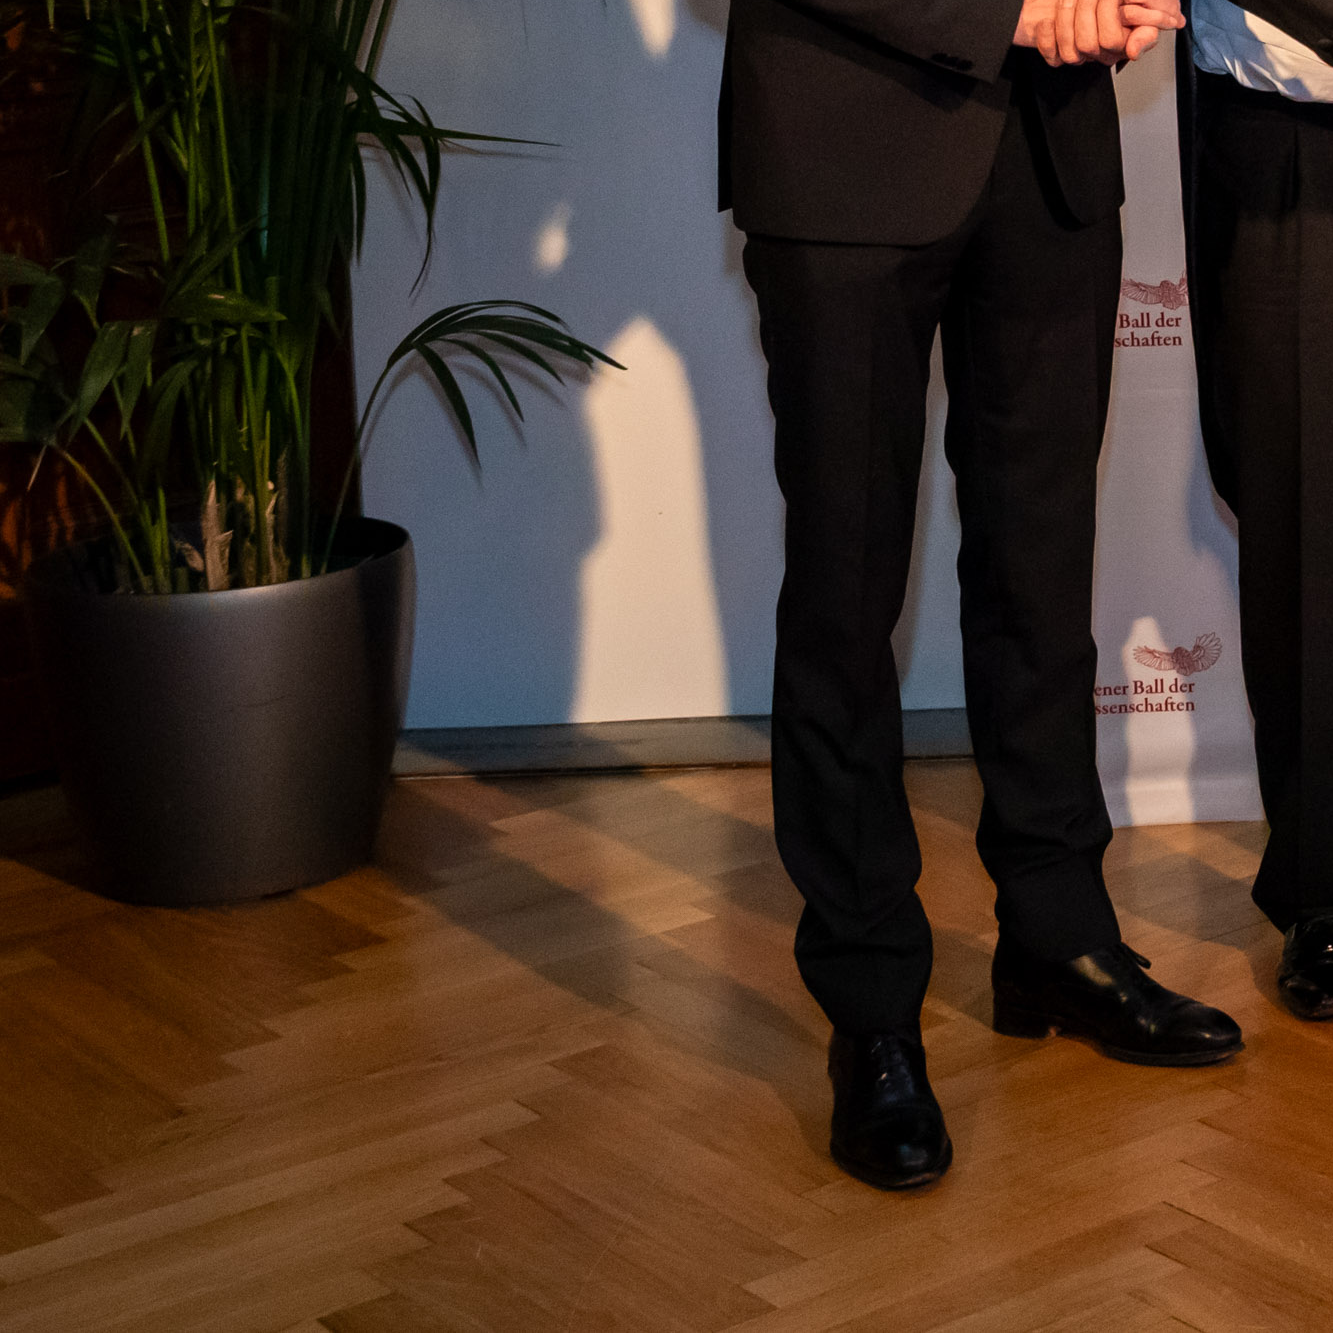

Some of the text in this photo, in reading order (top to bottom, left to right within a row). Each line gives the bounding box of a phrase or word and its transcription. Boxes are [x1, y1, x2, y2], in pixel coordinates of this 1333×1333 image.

[1118, 312, 1182, 328] Ball der
[1114, 331, 1183, 347] schaften
[1093, 677, 1195, 696] ener Ball der
[1095, 697, 1195, 714] ssenschaften
